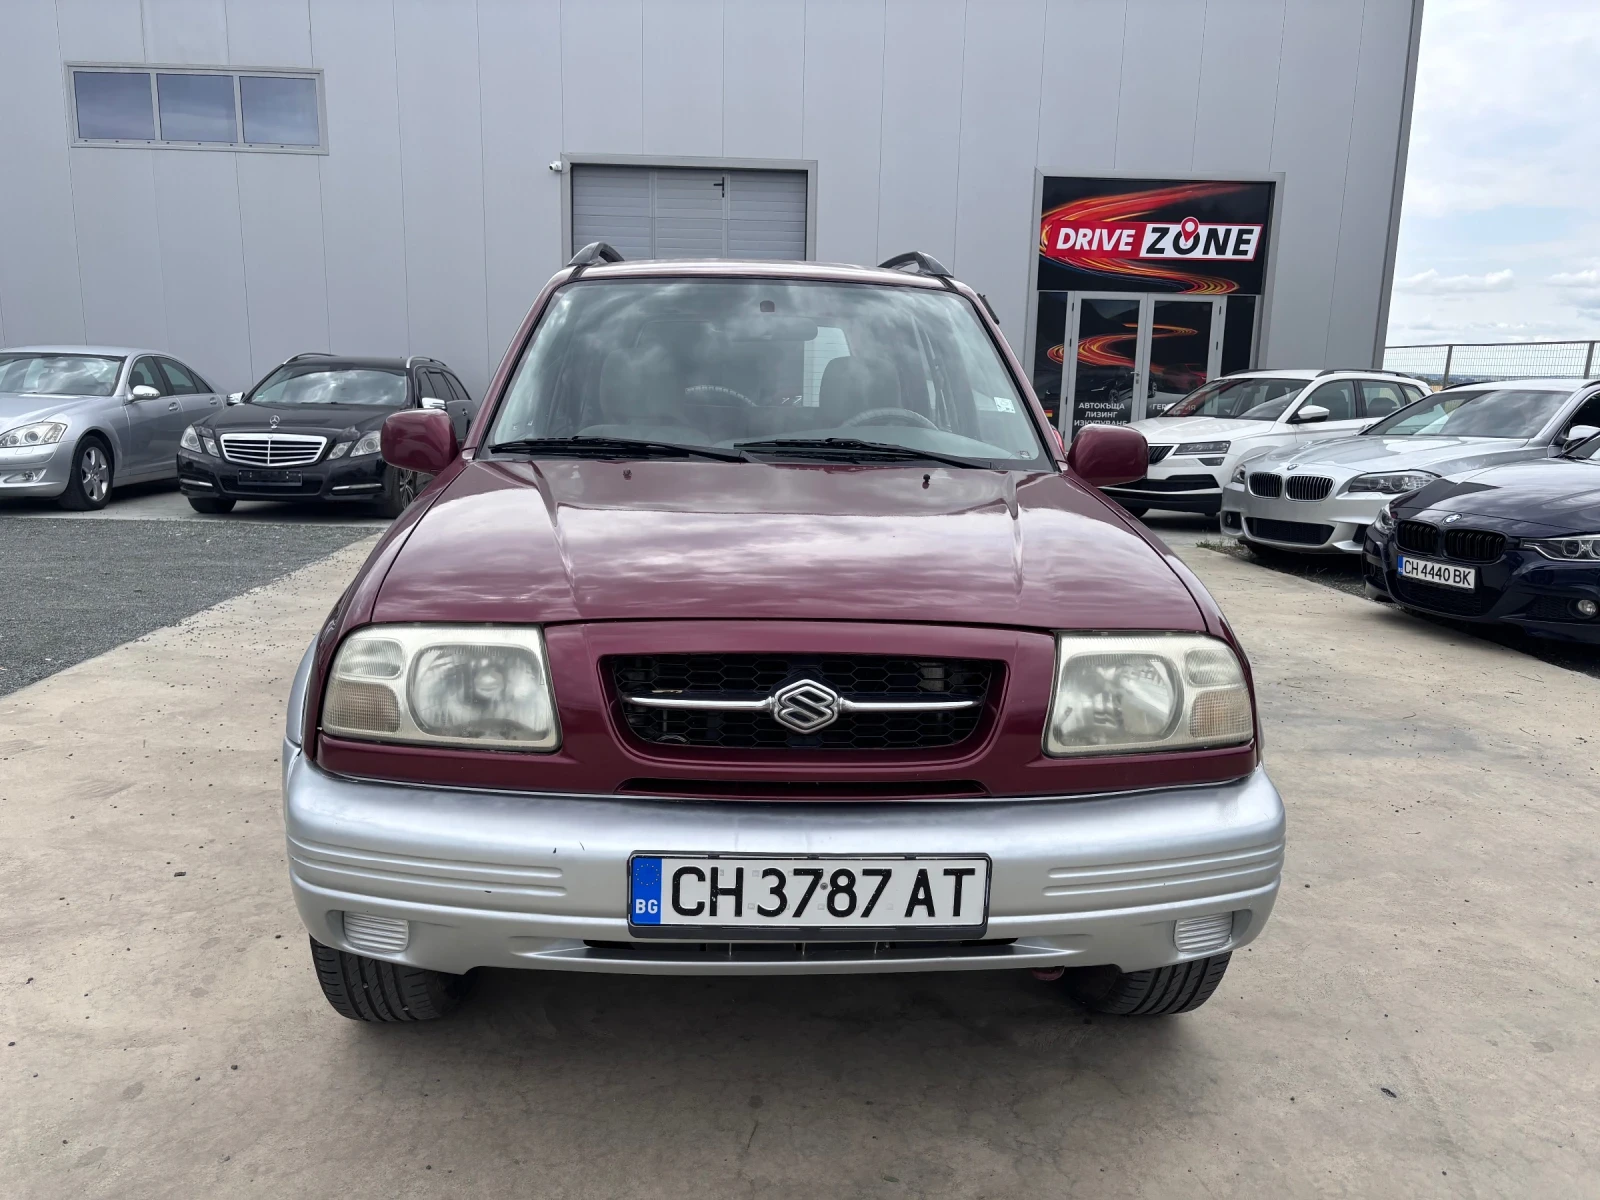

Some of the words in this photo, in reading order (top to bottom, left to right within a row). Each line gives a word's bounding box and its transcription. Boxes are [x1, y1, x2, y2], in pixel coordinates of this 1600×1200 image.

[1056, 228, 1136, 251] DRIVE
[1146, 227, 1255, 256] ZONE
[1078, 402, 1125, 410] АВТОКЪЩА
[1404, 560, 1419, 575] CH
[1421, 563, 1450, 581] 4440
[1453, 569, 1471, 586] BK
[671, 867, 744, 917] CH
[757, 868, 892, 917] 3787
[904, 868, 976, 917] AT
[635, 898, 658, 914] BG
